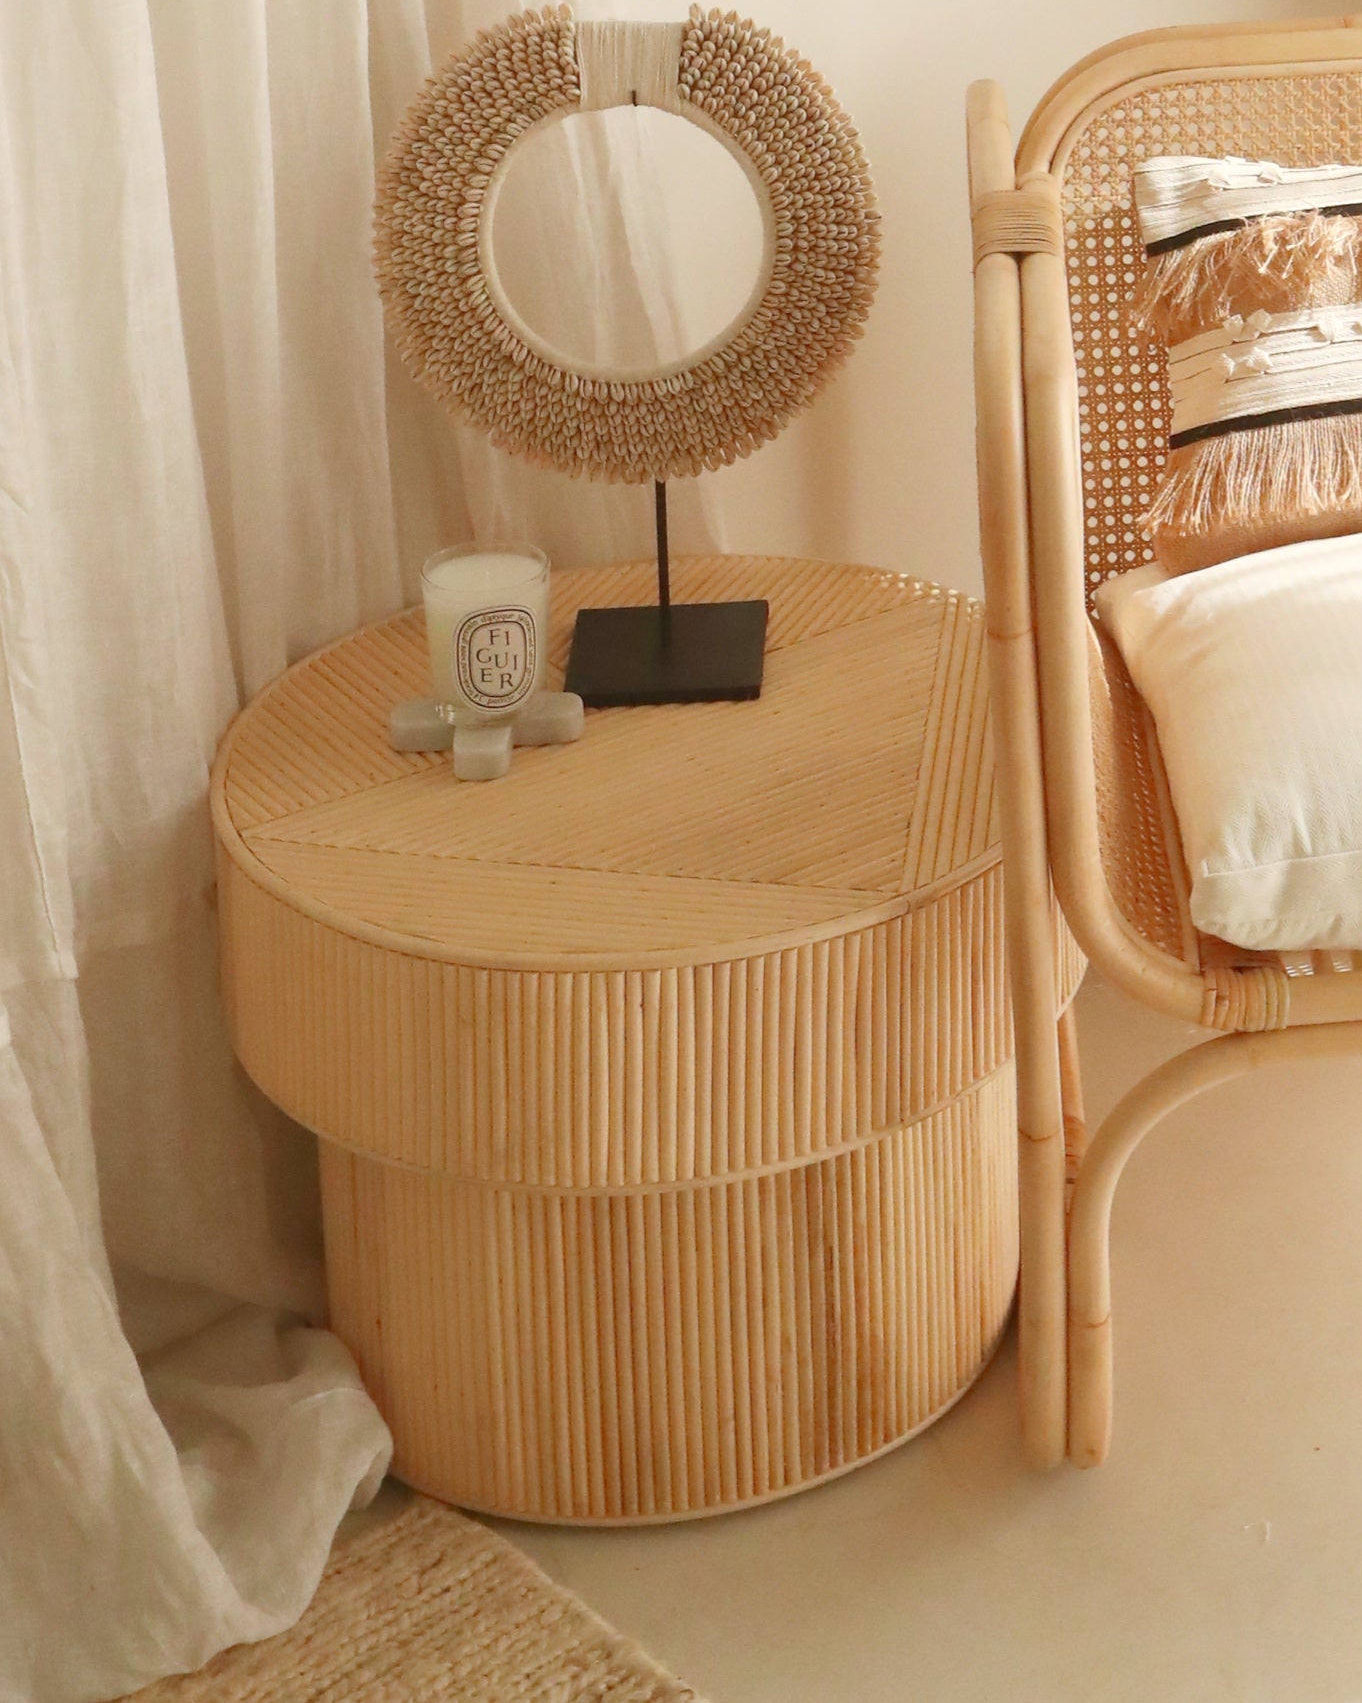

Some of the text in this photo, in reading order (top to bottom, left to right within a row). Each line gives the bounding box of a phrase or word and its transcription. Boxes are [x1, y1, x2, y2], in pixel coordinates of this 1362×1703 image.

[488, 628, 510, 646] FI
[476, 648, 517, 670] GUI
[480, 668, 513, 689] ER
